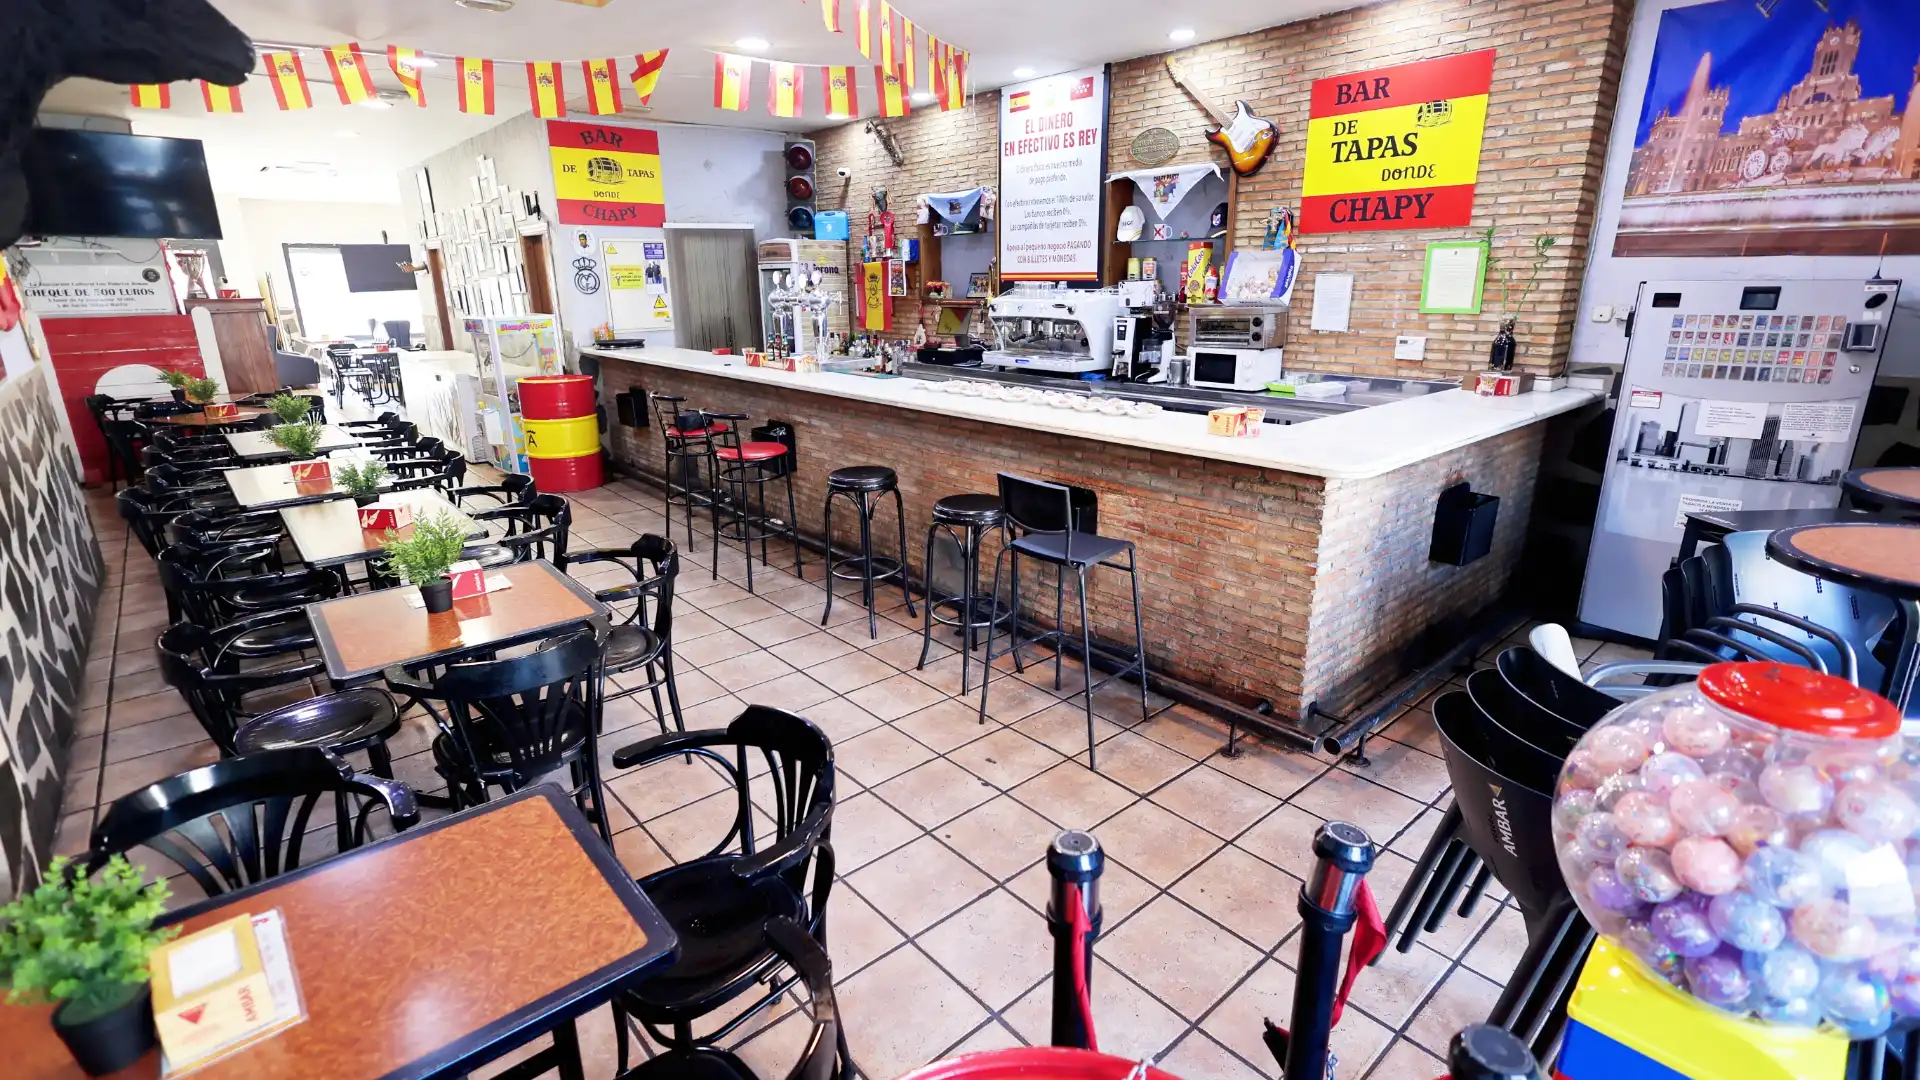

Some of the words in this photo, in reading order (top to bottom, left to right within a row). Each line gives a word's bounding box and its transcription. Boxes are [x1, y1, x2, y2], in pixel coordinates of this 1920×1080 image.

[1334, 76, 1391, 106] BAR
[1025, 118, 1034, 134] EL
[1038, 111, 1073, 132] DINERO
[1333, 120, 1358, 137] DE
[580, 128, 624, 148] BAR
[1004, 141, 1015, 156] EN
[1018, 134, 1060, 155] EFECTIVO
[1063, 132, 1075, 148] ES
[1078, 127, 1097, 146] REY
[1331, 132, 1418, 163] TAPAS
[562, 164, 577, 173] DE
[627, 168, 655, 178] TAPAS
[1381, 164, 1437, 182] DONDE
[583, 204, 638, 221] CHAPY
[1329, 193, 1434, 224] CHAPY
[24, 288, 71, 297] CHEQUE
[74, 288, 90, 296] DE
[119, 288, 155, 296] EUROS
[1491, 797, 1518, 857] AMBAR
